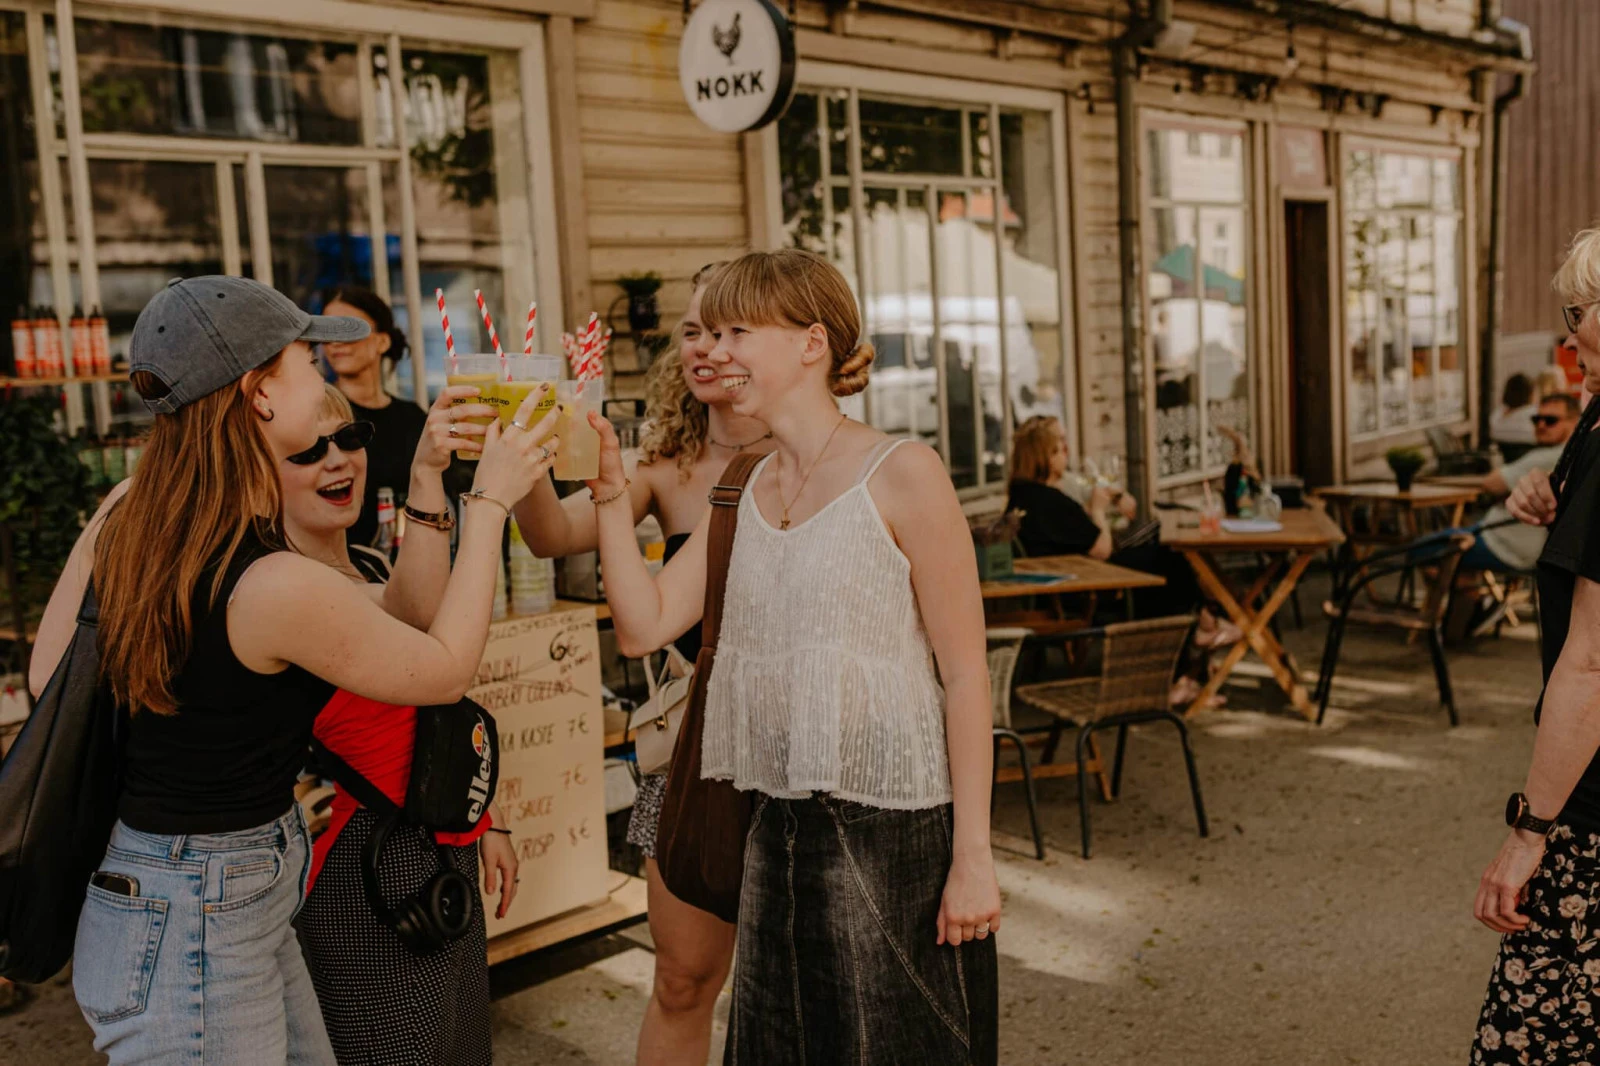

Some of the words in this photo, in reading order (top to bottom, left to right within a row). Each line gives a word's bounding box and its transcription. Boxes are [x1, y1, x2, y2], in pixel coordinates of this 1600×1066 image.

[697, 69, 764, 101] NOKK
[499, 731, 515, 752] KA
[521, 722, 555, 750] KASTE
[516, 795, 554, 821] SAUCE
